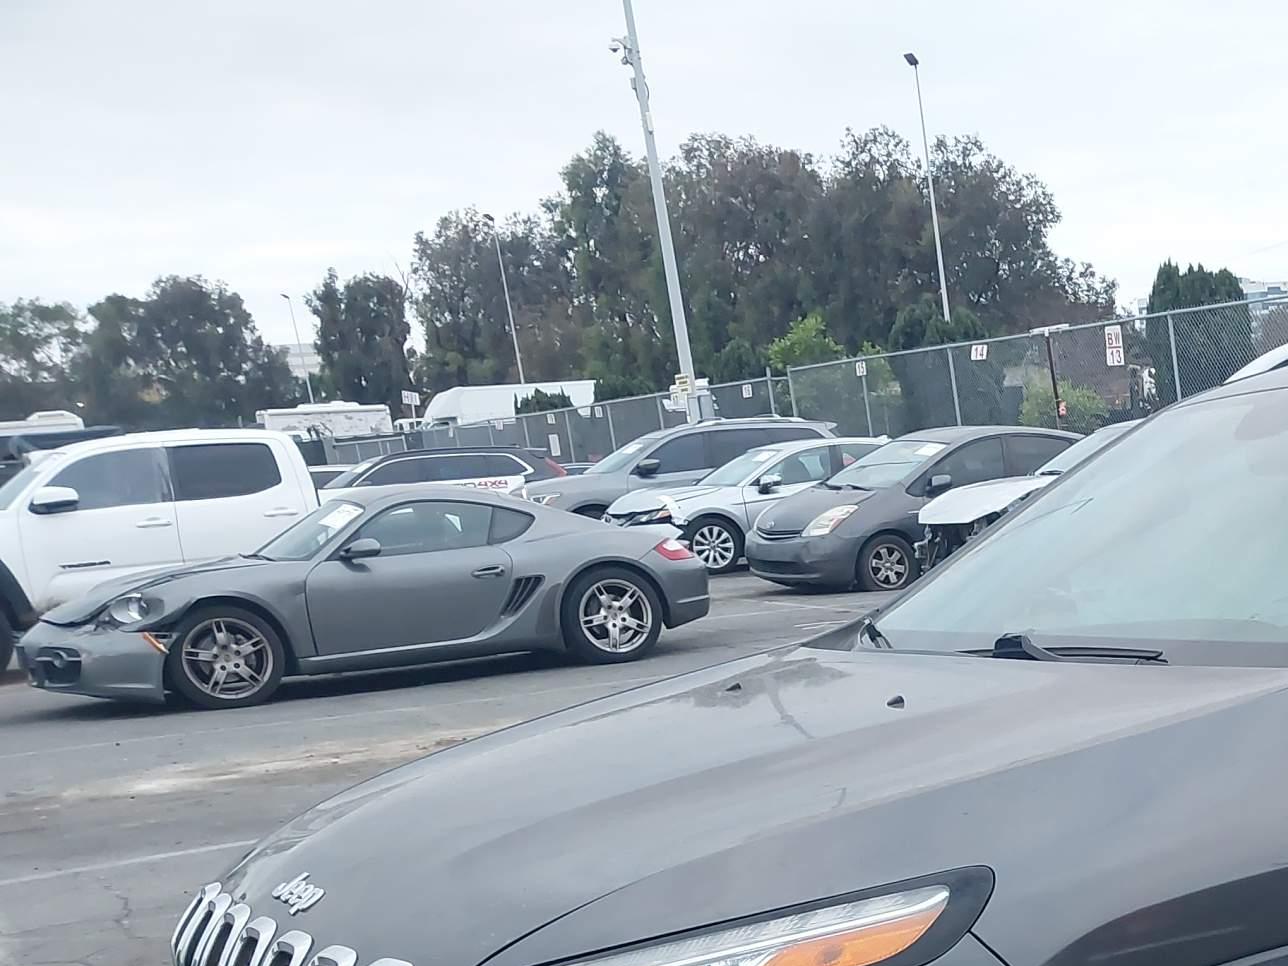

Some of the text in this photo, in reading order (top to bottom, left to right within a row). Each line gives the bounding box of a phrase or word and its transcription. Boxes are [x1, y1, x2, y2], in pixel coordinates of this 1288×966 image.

[1107, 331, 1121, 345] BW
[1110, 349, 1122, 364] 13
[271, 871, 326, 917] Jeep
